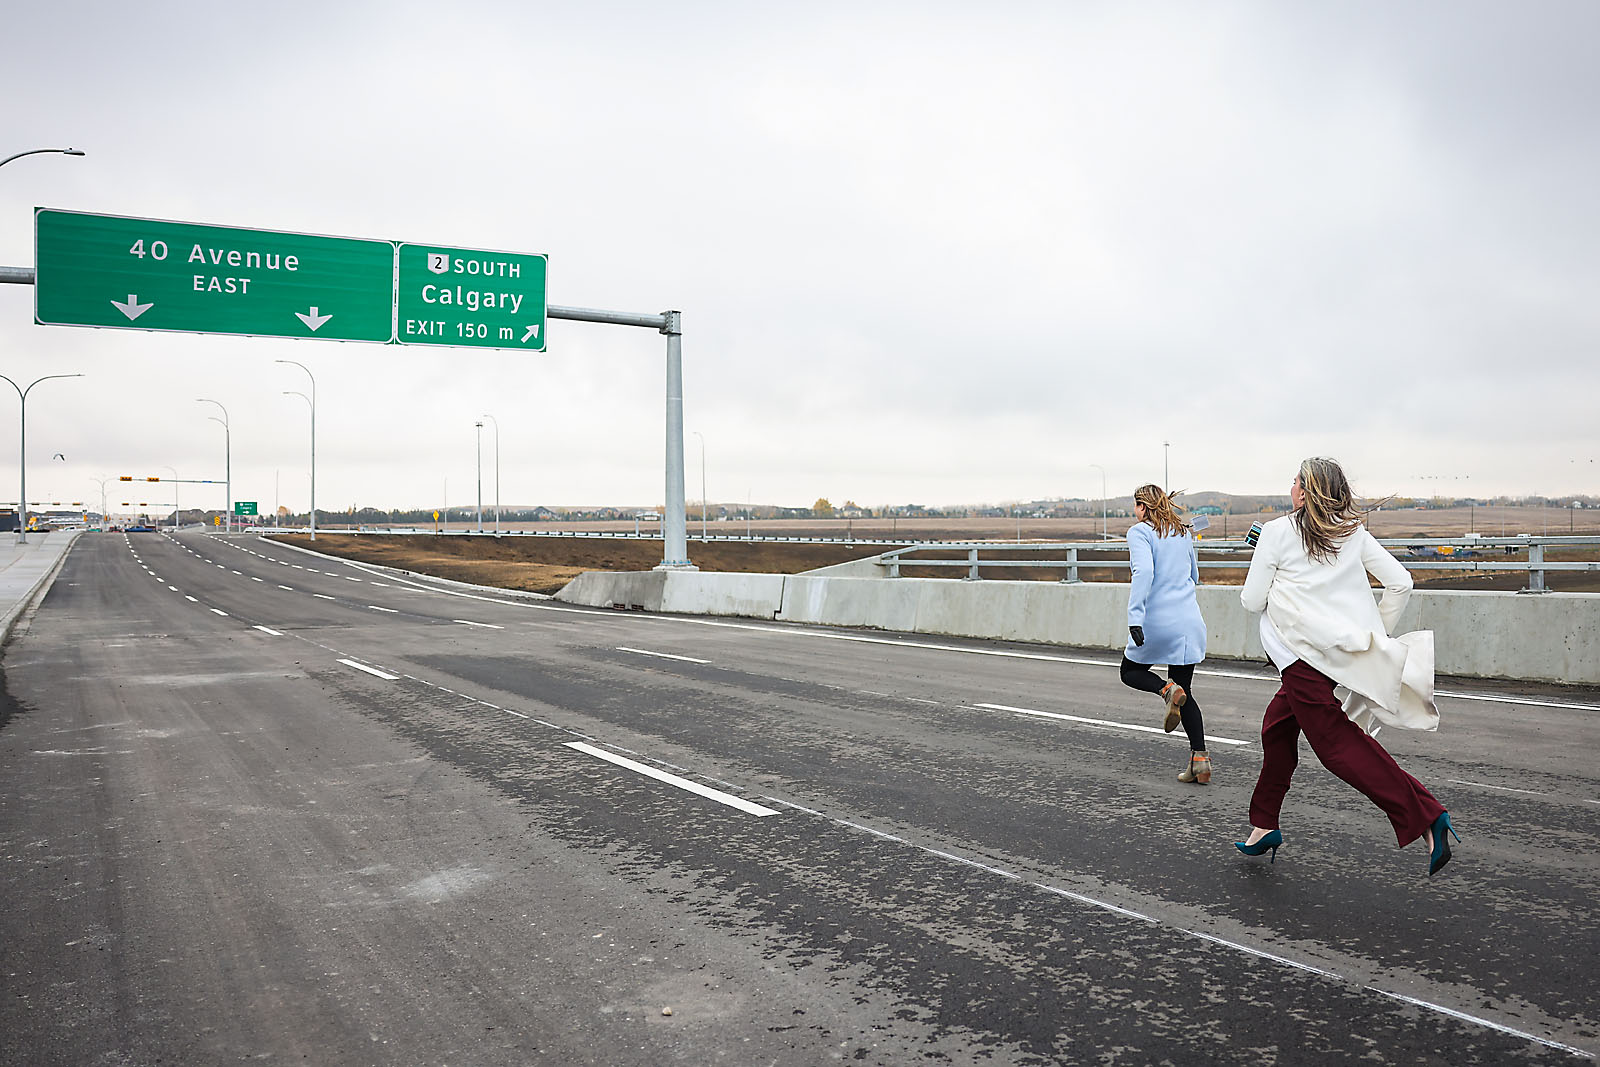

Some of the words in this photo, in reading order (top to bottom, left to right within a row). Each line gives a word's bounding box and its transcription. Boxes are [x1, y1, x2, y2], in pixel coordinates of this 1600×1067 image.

[129, 239, 169, 261] 40
[188, 243, 300, 271] Avenue
[434, 256, 442, 270] 2
[454, 258, 521, 278] SOUTH
[193, 275, 251, 295] EAST
[421, 284, 524, 314] Calgary
[406, 319, 446, 336] EXIT
[456, 322, 488, 339] 150
[499, 326, 513, 340] m
